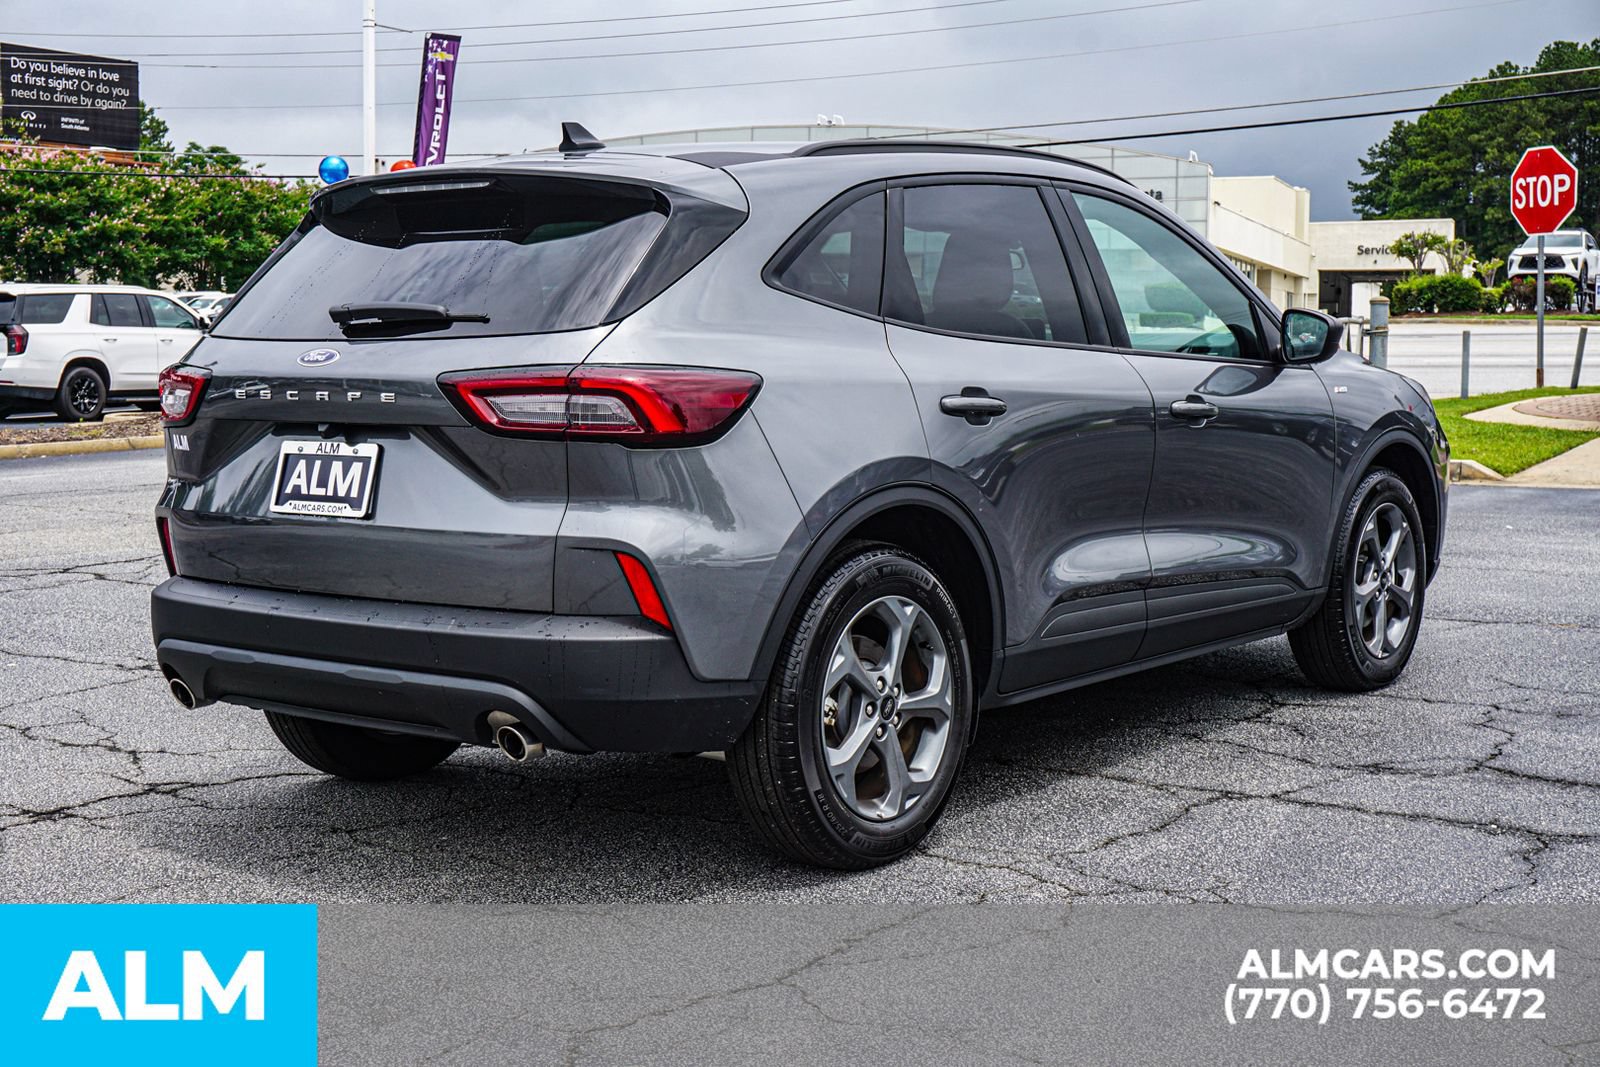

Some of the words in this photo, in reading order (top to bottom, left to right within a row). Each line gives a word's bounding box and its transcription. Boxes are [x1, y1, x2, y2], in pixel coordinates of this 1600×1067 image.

[10, 56, 27, 69] Do
[29, 61, 49, 73] you
[51, 62, 86, 77] believe
[87, 66, 97, 79] in
[99, 68, 120, 81] love
[10, 73, 22, 83] at
[24, 72, 46, 86] first
[48, 76, 79, 91] sight?
[80, 80, 95, 92] Or
[96, 82, 110, 94] do
[111, 86, 130, 98] you
[11, 88, 37, 100] need
[39, 90, 51, 101] to
[53, 92, 78, 105] drive
[80, 94, 92, 108] by
[94, 97, 127, 111] again?
[426, 69, 446, 166] VROLET
[1514, 173, 1571, 210] STOP
[1357, 244, 1392, 256] Servic
[235, 389, 397, 403] ESCAPE
[173, 434, 190, 451] ALM
[315, 442, 341, 455] ALM
[284, 459, 364, 498] ALM
[291, 502, 345, 514] ALMCARS.COM
[882, 565, 933, 590] MICHELIN
[936, 587, 957, 619] PRIMACY
